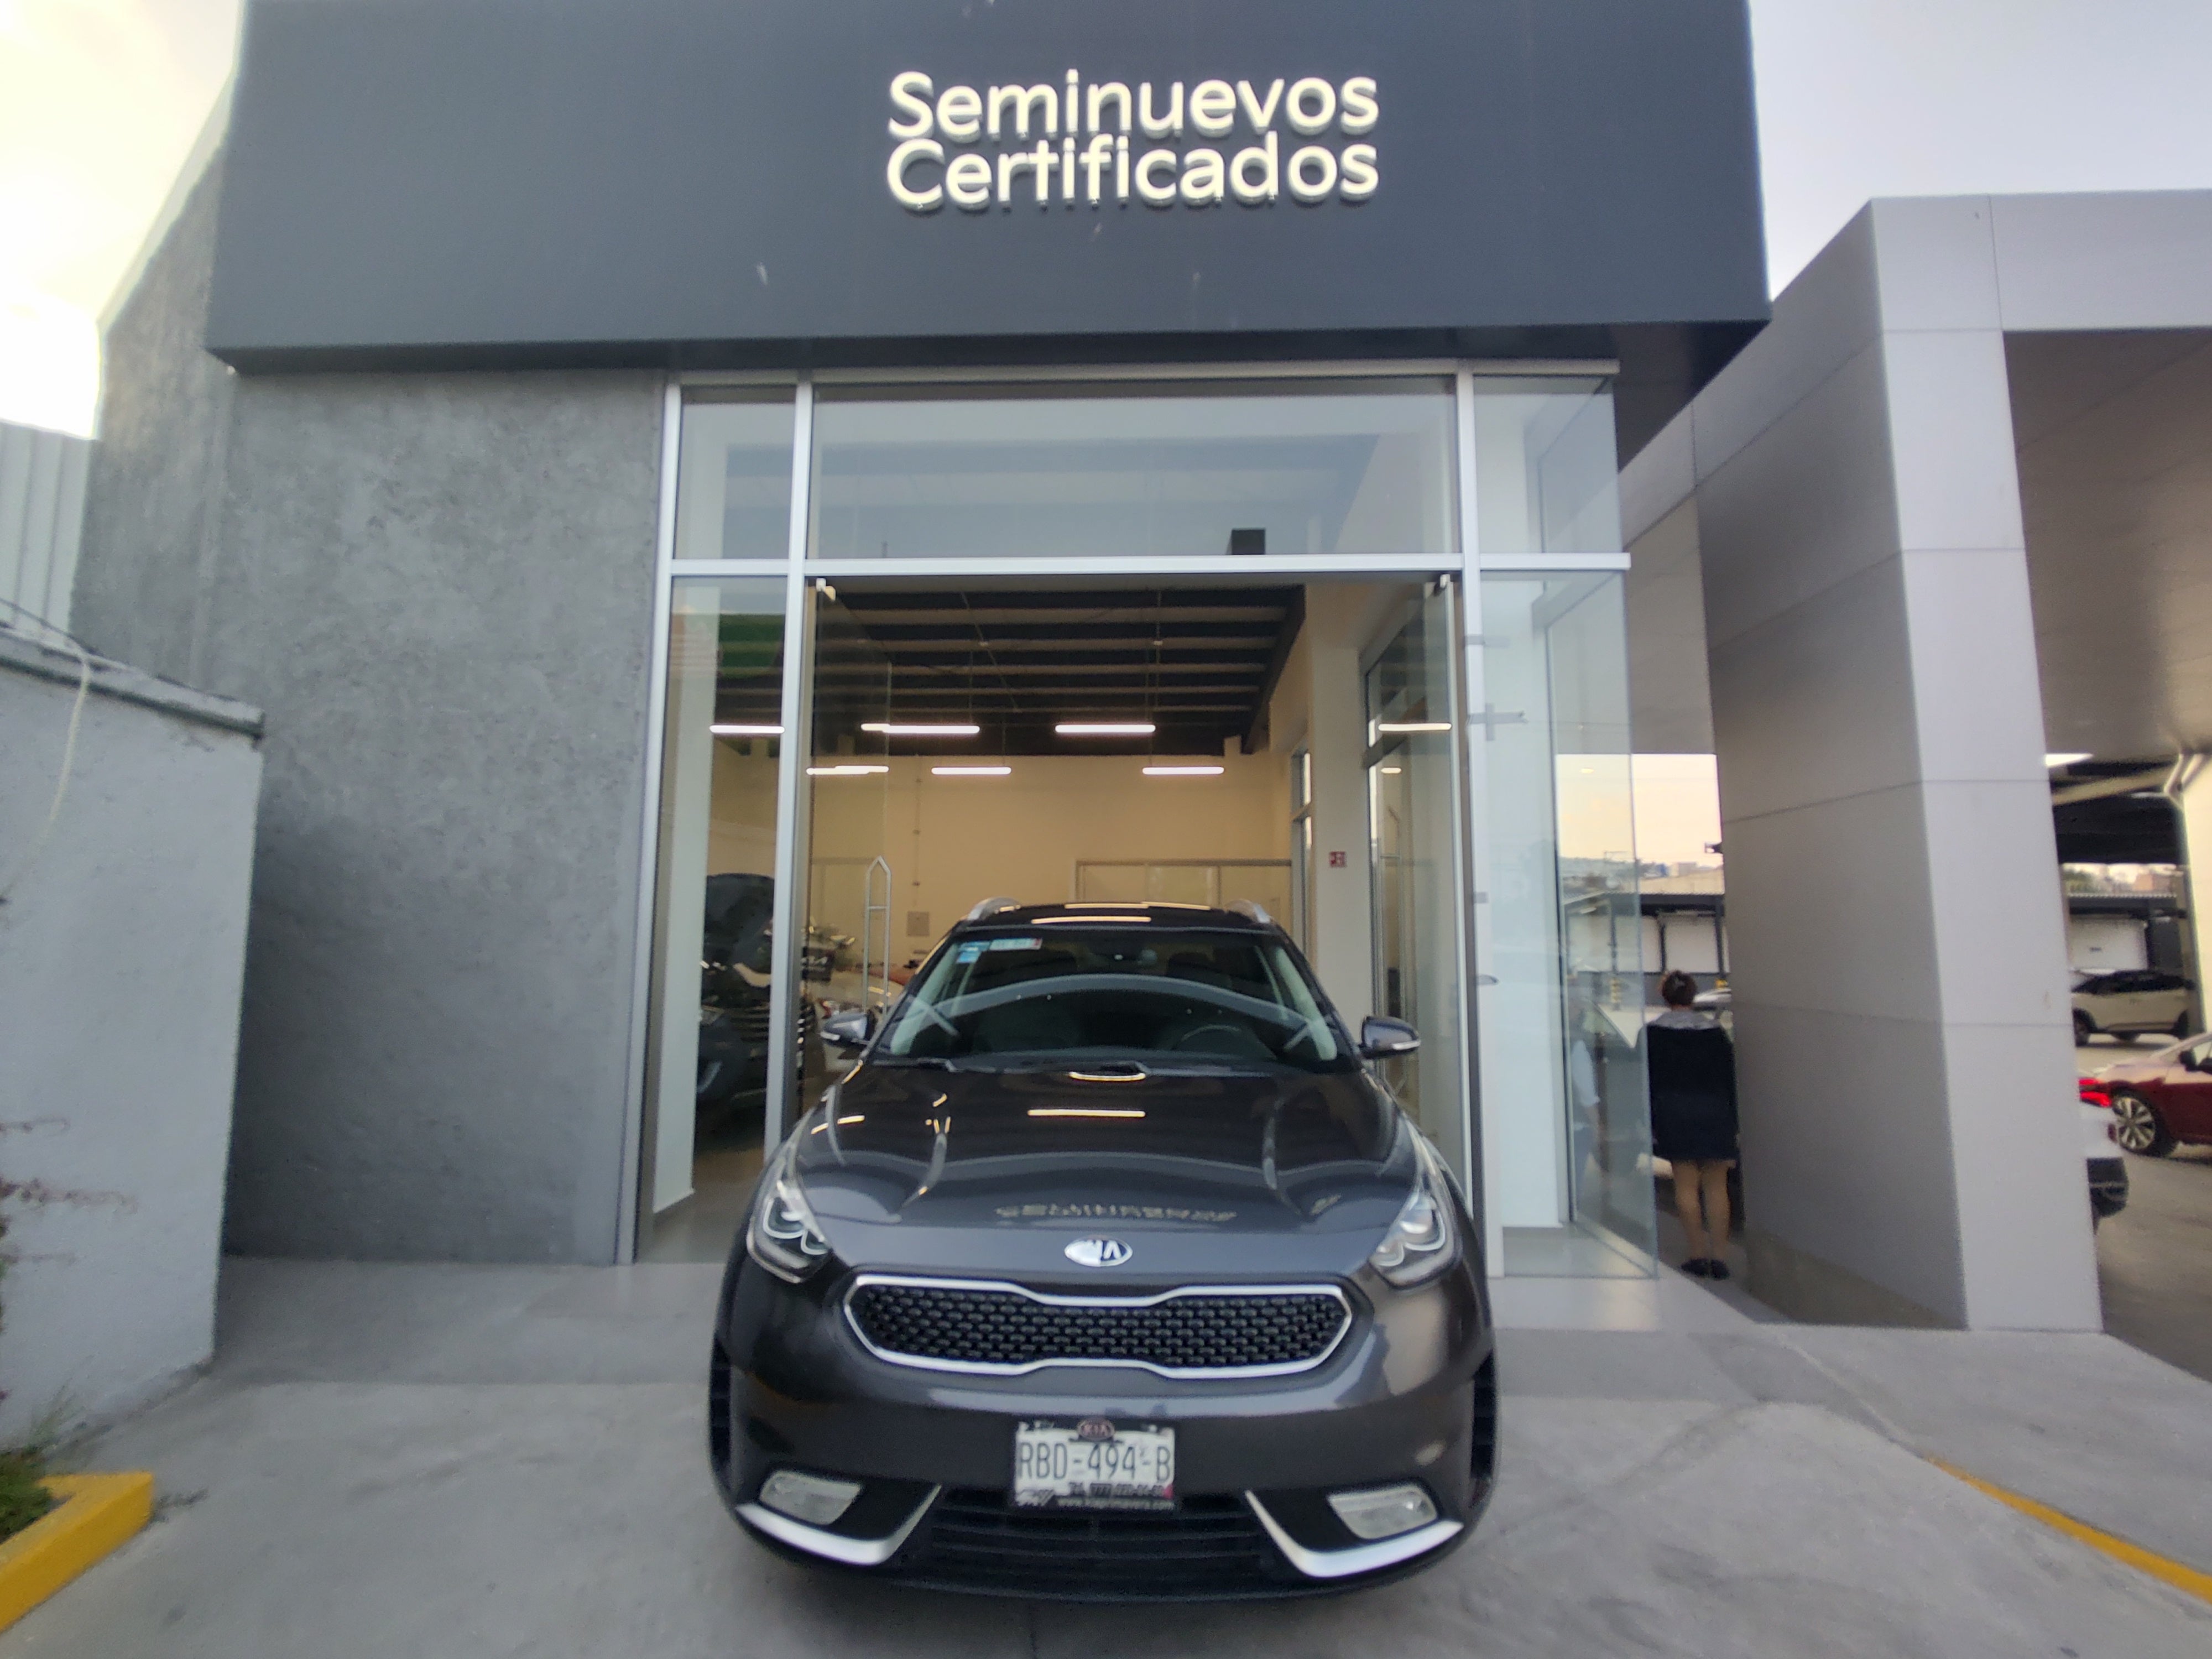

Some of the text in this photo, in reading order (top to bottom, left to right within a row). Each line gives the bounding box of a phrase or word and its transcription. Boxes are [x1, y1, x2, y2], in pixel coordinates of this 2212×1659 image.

[888, 69, 1379, 142] Seminuevos
[886, 131, 1379, 210] Certificados
[1019, 1442, 1171, 1482] RBD-494-B
